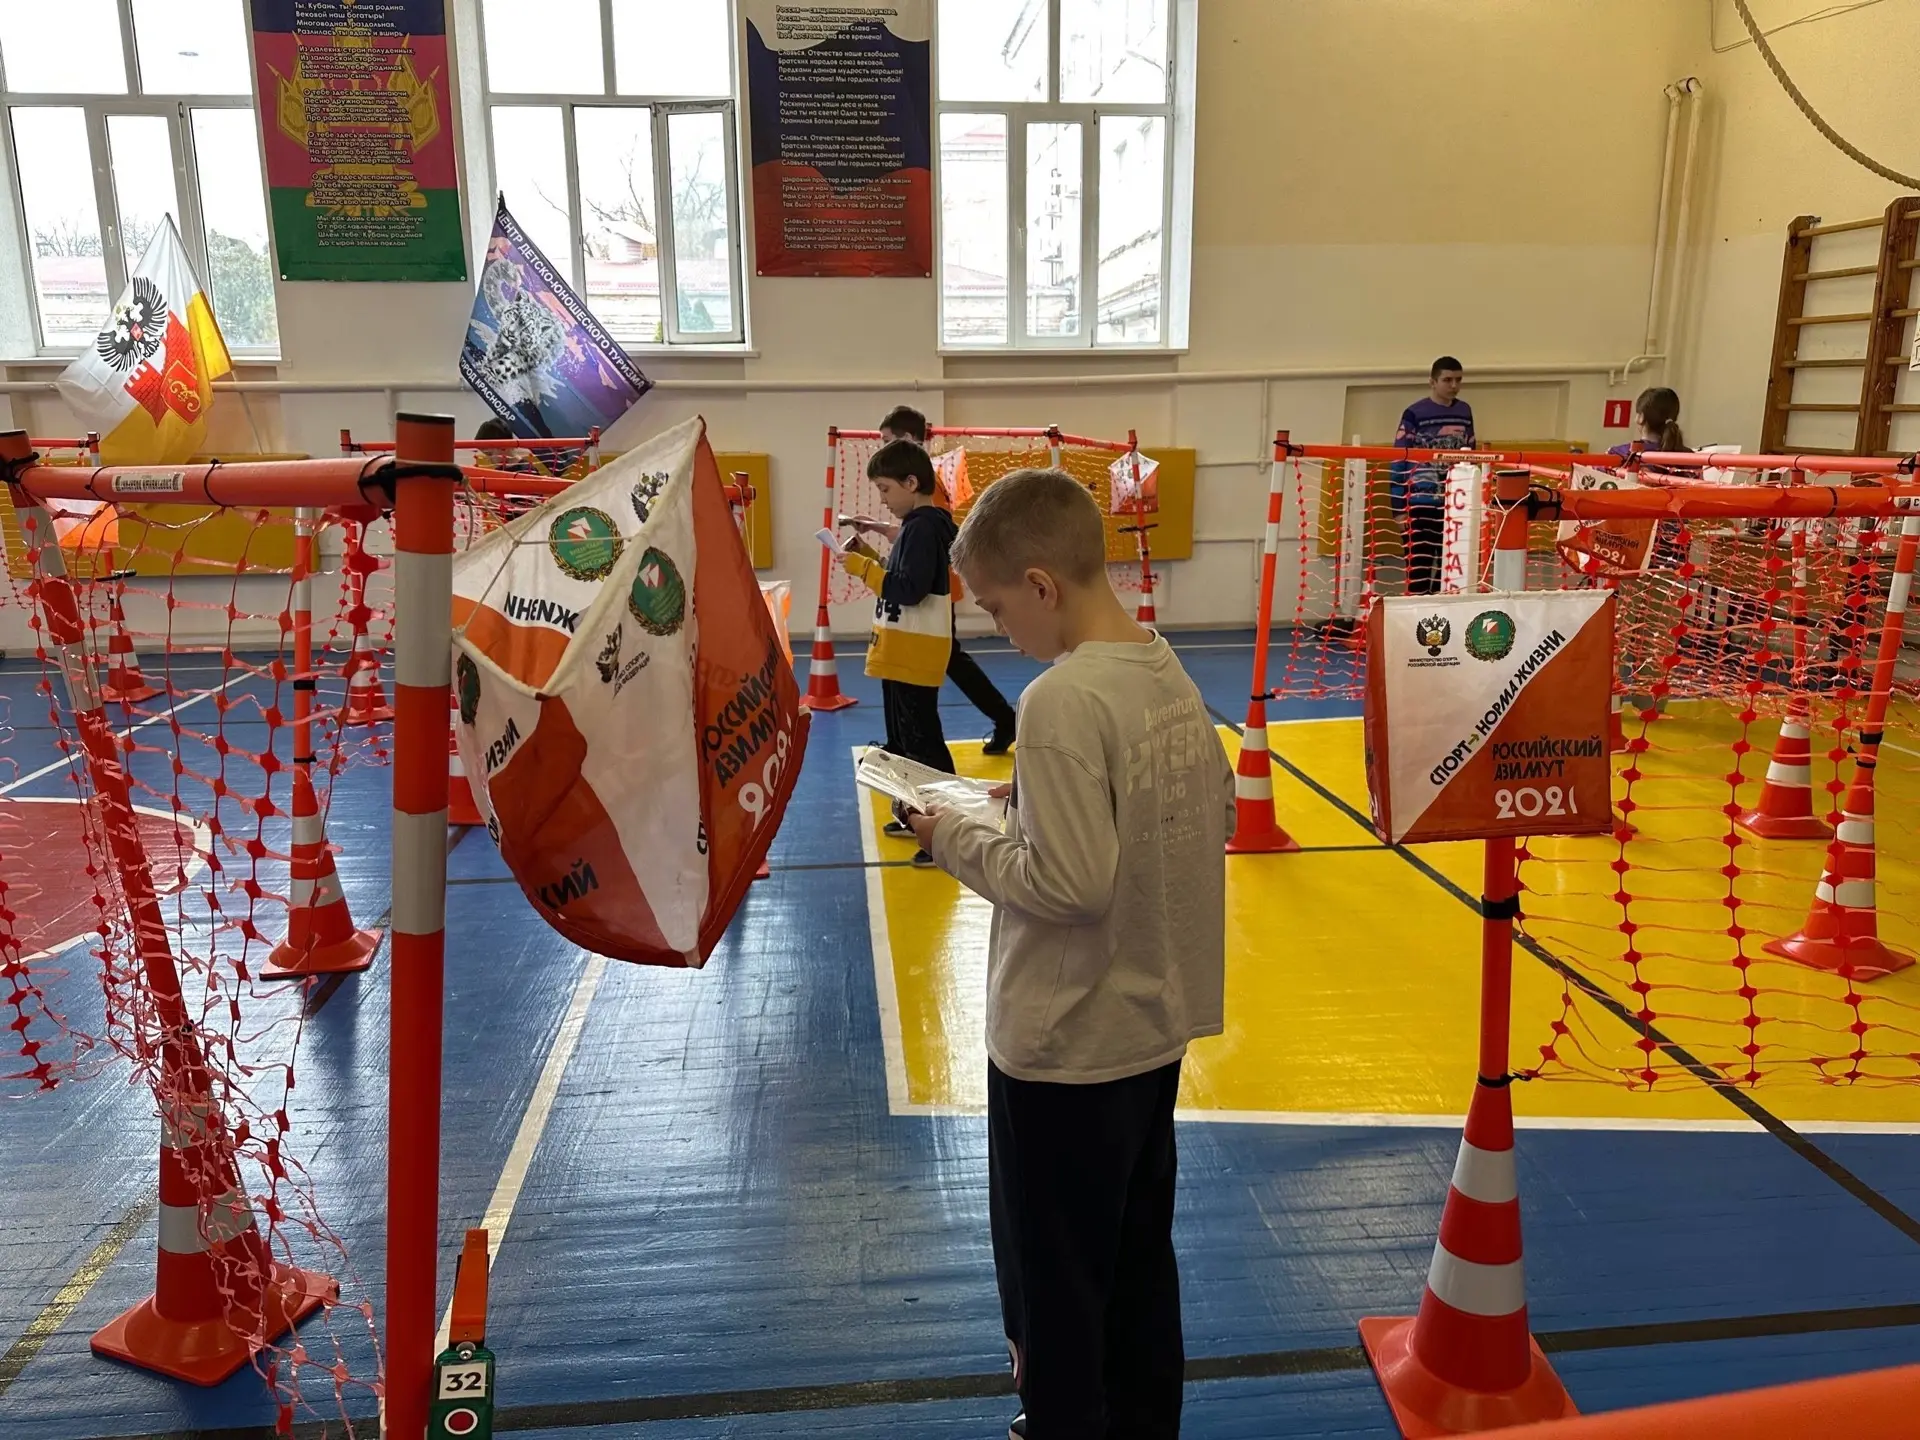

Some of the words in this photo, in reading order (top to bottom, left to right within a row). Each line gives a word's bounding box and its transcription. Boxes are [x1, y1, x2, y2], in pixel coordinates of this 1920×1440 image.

[518, 243, 610, 349] ДЕТСКО-ЮНОШЕСКОГО
[608, 347, 645, 389] ТУРИЗМА
[461, 358, 477, 382] ОРОД
[475, 379, 516, 421] КРАСНОДАР
[1593, 543, 1626, 565] 2021
[1430, 740, 1473, 786] СПОРТ
[1475, 680, 1519, 737] НОРМА
[1514, 629, 1566, 688] ЖИЗНИ
[1492, 735, 1602, 760] РОССИЙСКИЙ
[1494, 760, 1565, 781] АЗИМУТ
[1495, 785, 1579, 819] 2021
[445, 1371, 482, 1392] 32
